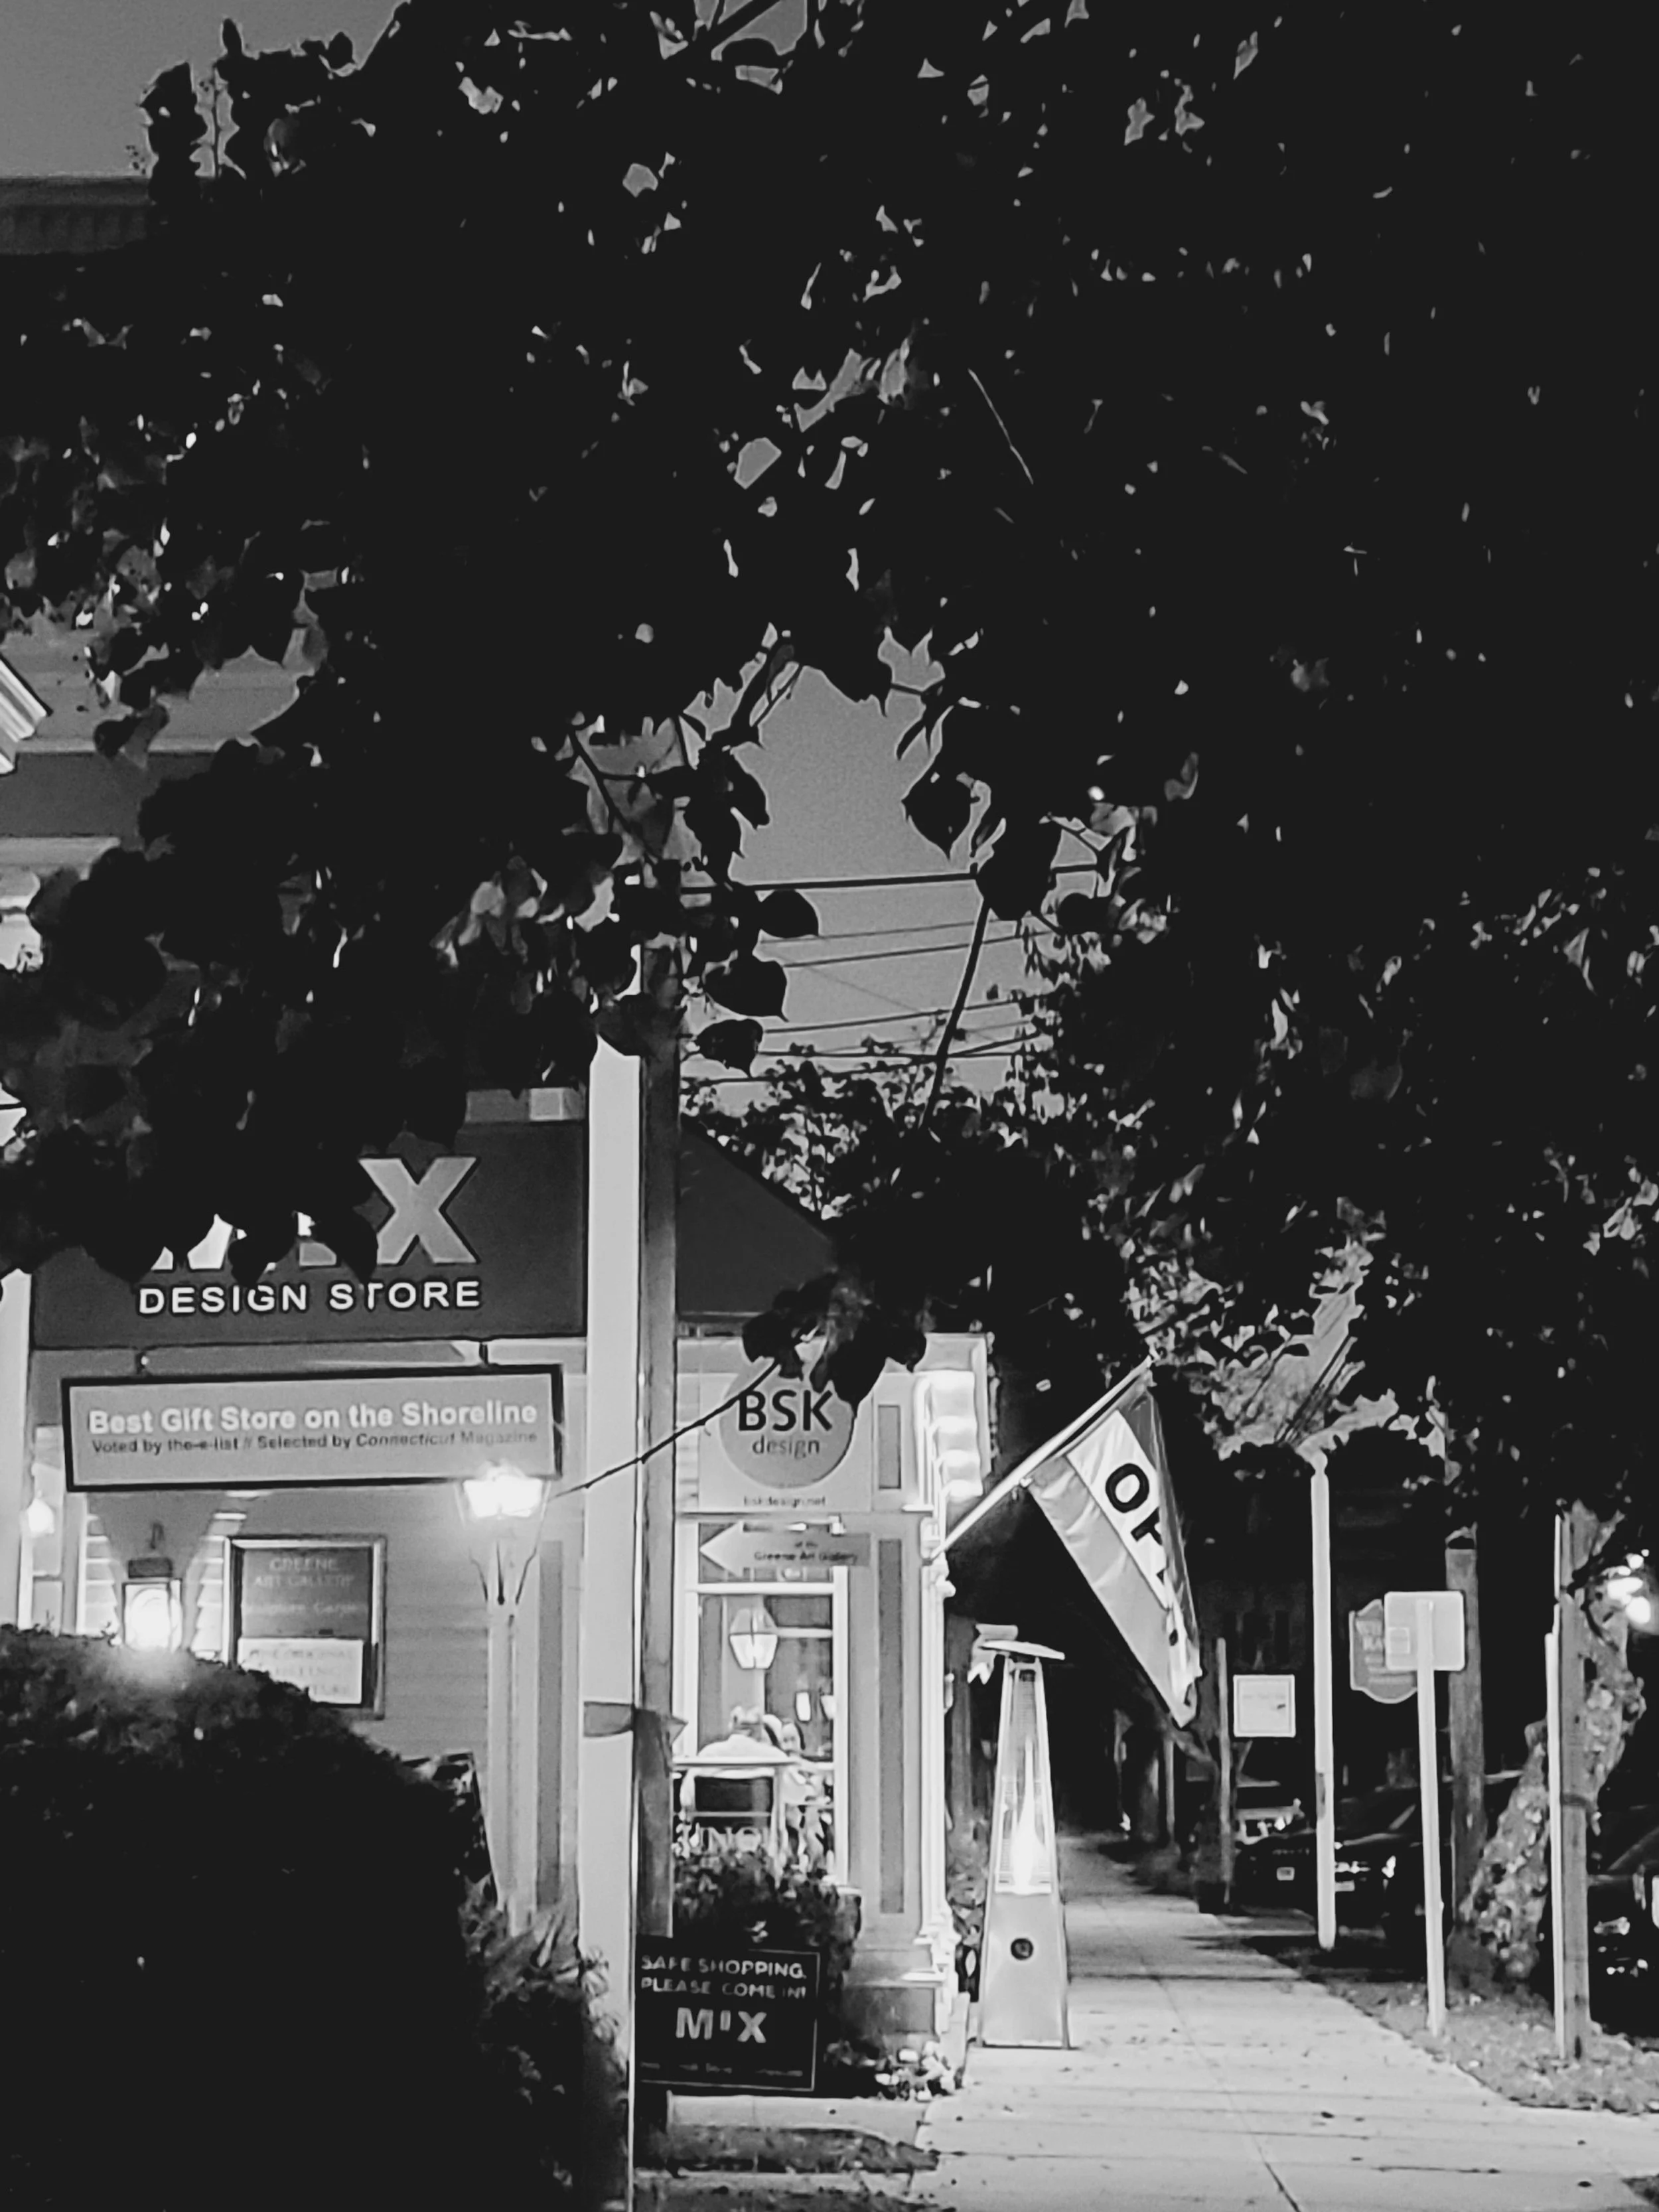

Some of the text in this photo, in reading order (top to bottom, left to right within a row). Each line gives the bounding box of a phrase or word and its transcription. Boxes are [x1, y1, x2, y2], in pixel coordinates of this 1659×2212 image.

[139, 1280, 480, 1314] DESIGN STORE
[90, 1399, 538, 1434] Best Gift Store on the Shoreline
[739, 1390, 833, 1431] BSK
[92, 1439, 137, 1453] Voted
[143, 1438, 162, 1455] by
[257, 1435, 326, 1449] Selected
[332, 1435, 351, 1449] by
[356, 1433, 455, 1447] Connecticut
[753, 1434, 820, 1459] design
[641, 1976, 711, 1995] PLEASE
[721, 1982, 776, 1999] COME
[676, 2007, 767, 2043] MIX
